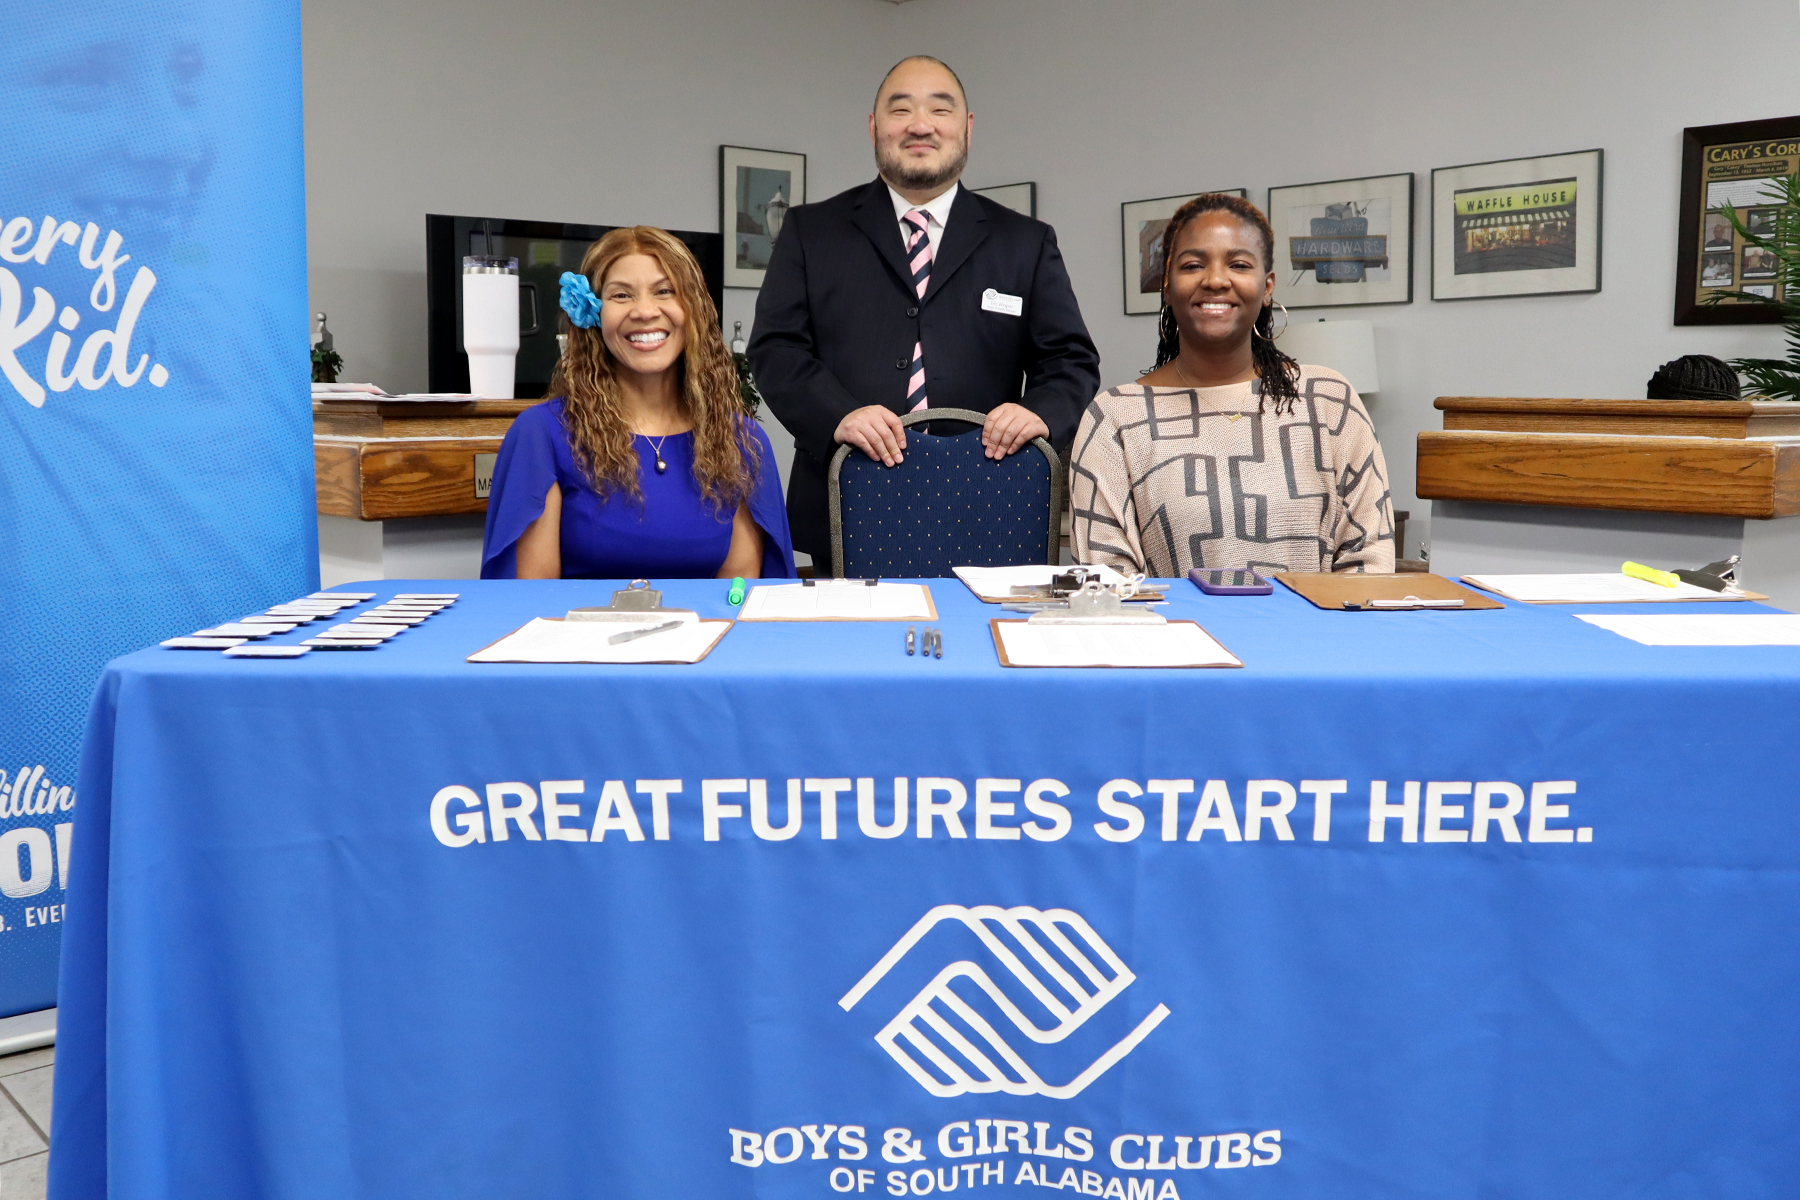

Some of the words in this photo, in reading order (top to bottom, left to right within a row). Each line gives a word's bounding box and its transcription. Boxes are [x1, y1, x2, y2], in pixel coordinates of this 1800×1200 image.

[1710, 145, 1761, 162] CARY'S
[1467, 196, 1512, 212] WAFFLE
[1523, 190, 1567, 206] HOUSE
[0, 215, 130, 312] ery
[1296, 240, 1382, 255] HARDWARE
[0, 764, 76, 819] illin
[430, 779, 683, 847] GREAT
[702, 777, 1072, 842] FUTURES
[1094, 778, 1347, 842] START
[1368, 780, 1593, 843] HERE.
[729, 1124, 868, 1168] BOYS
[881, 1127, 926, 1163] &
[937, 1119, 1094, 1162] GIRLS
[1110, 1130, 1282, 1170] CLUBS
[829, 1167, 876, 1193] OF
[886, 1160, 1005, 1196] SOUTH
[1014, 1161, 1181, 1200] ALABAMA
